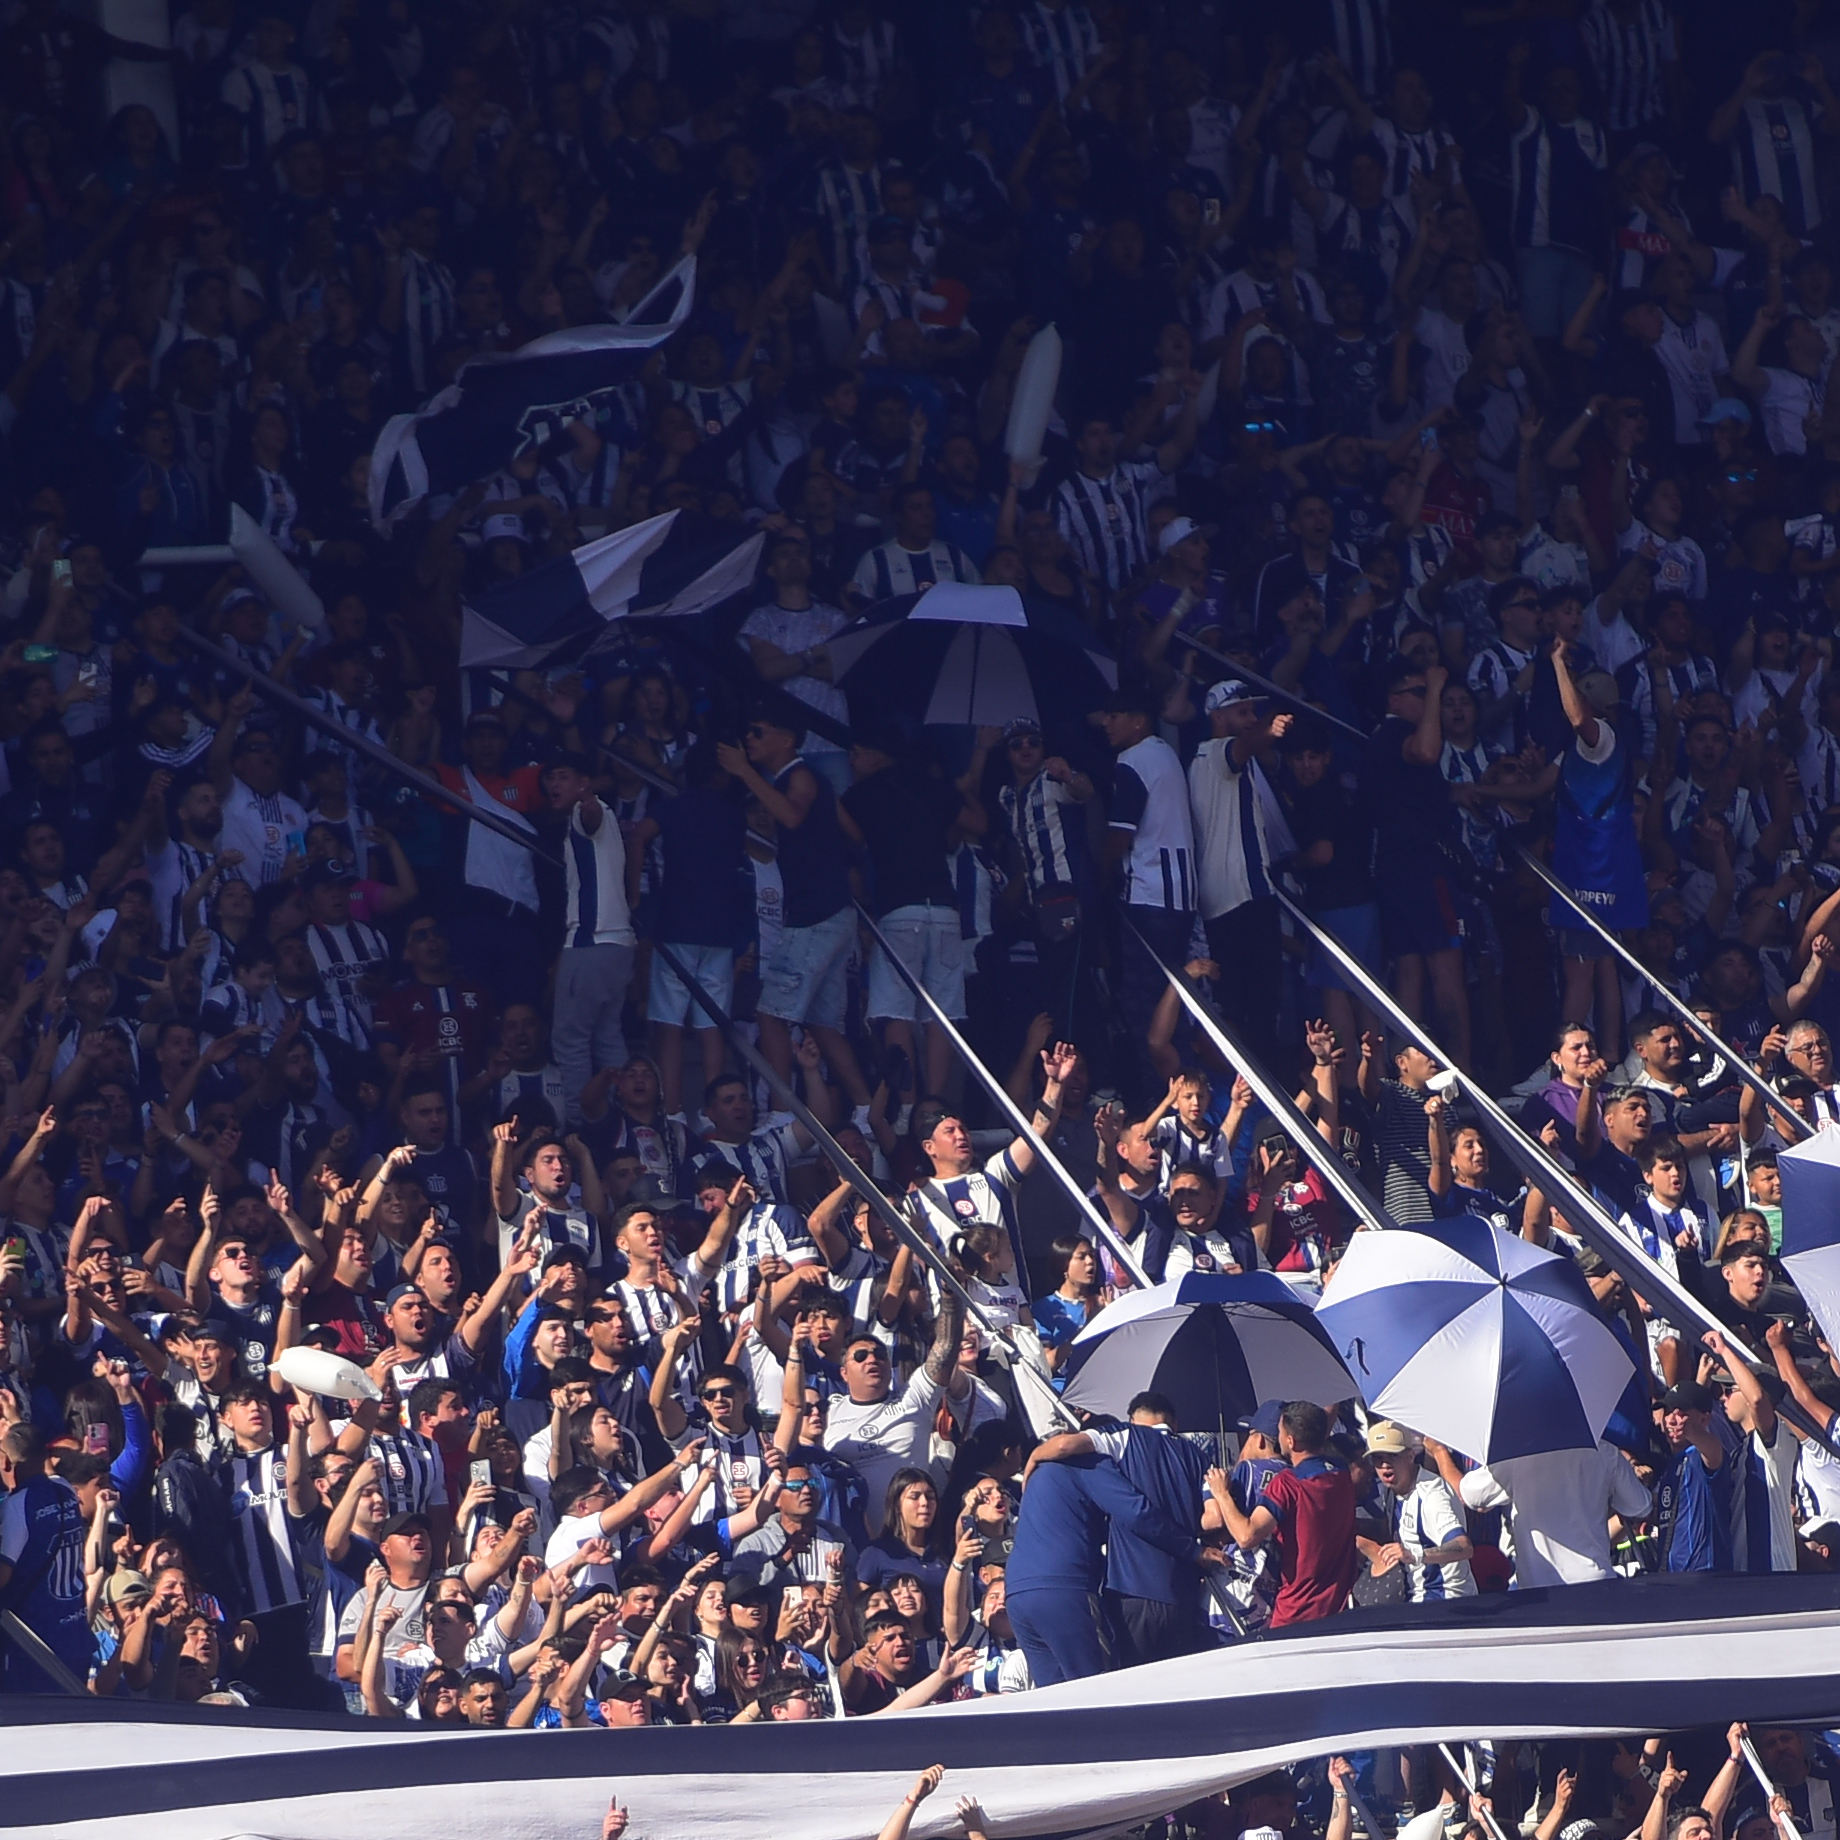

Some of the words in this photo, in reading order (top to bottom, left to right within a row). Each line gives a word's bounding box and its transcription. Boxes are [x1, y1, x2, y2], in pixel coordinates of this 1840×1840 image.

[438, 1035, 462, 1046] ICBC
[1290, 1213, 1315, 1228] ICBC
[249, 1488, 289, 1506] MOVI
